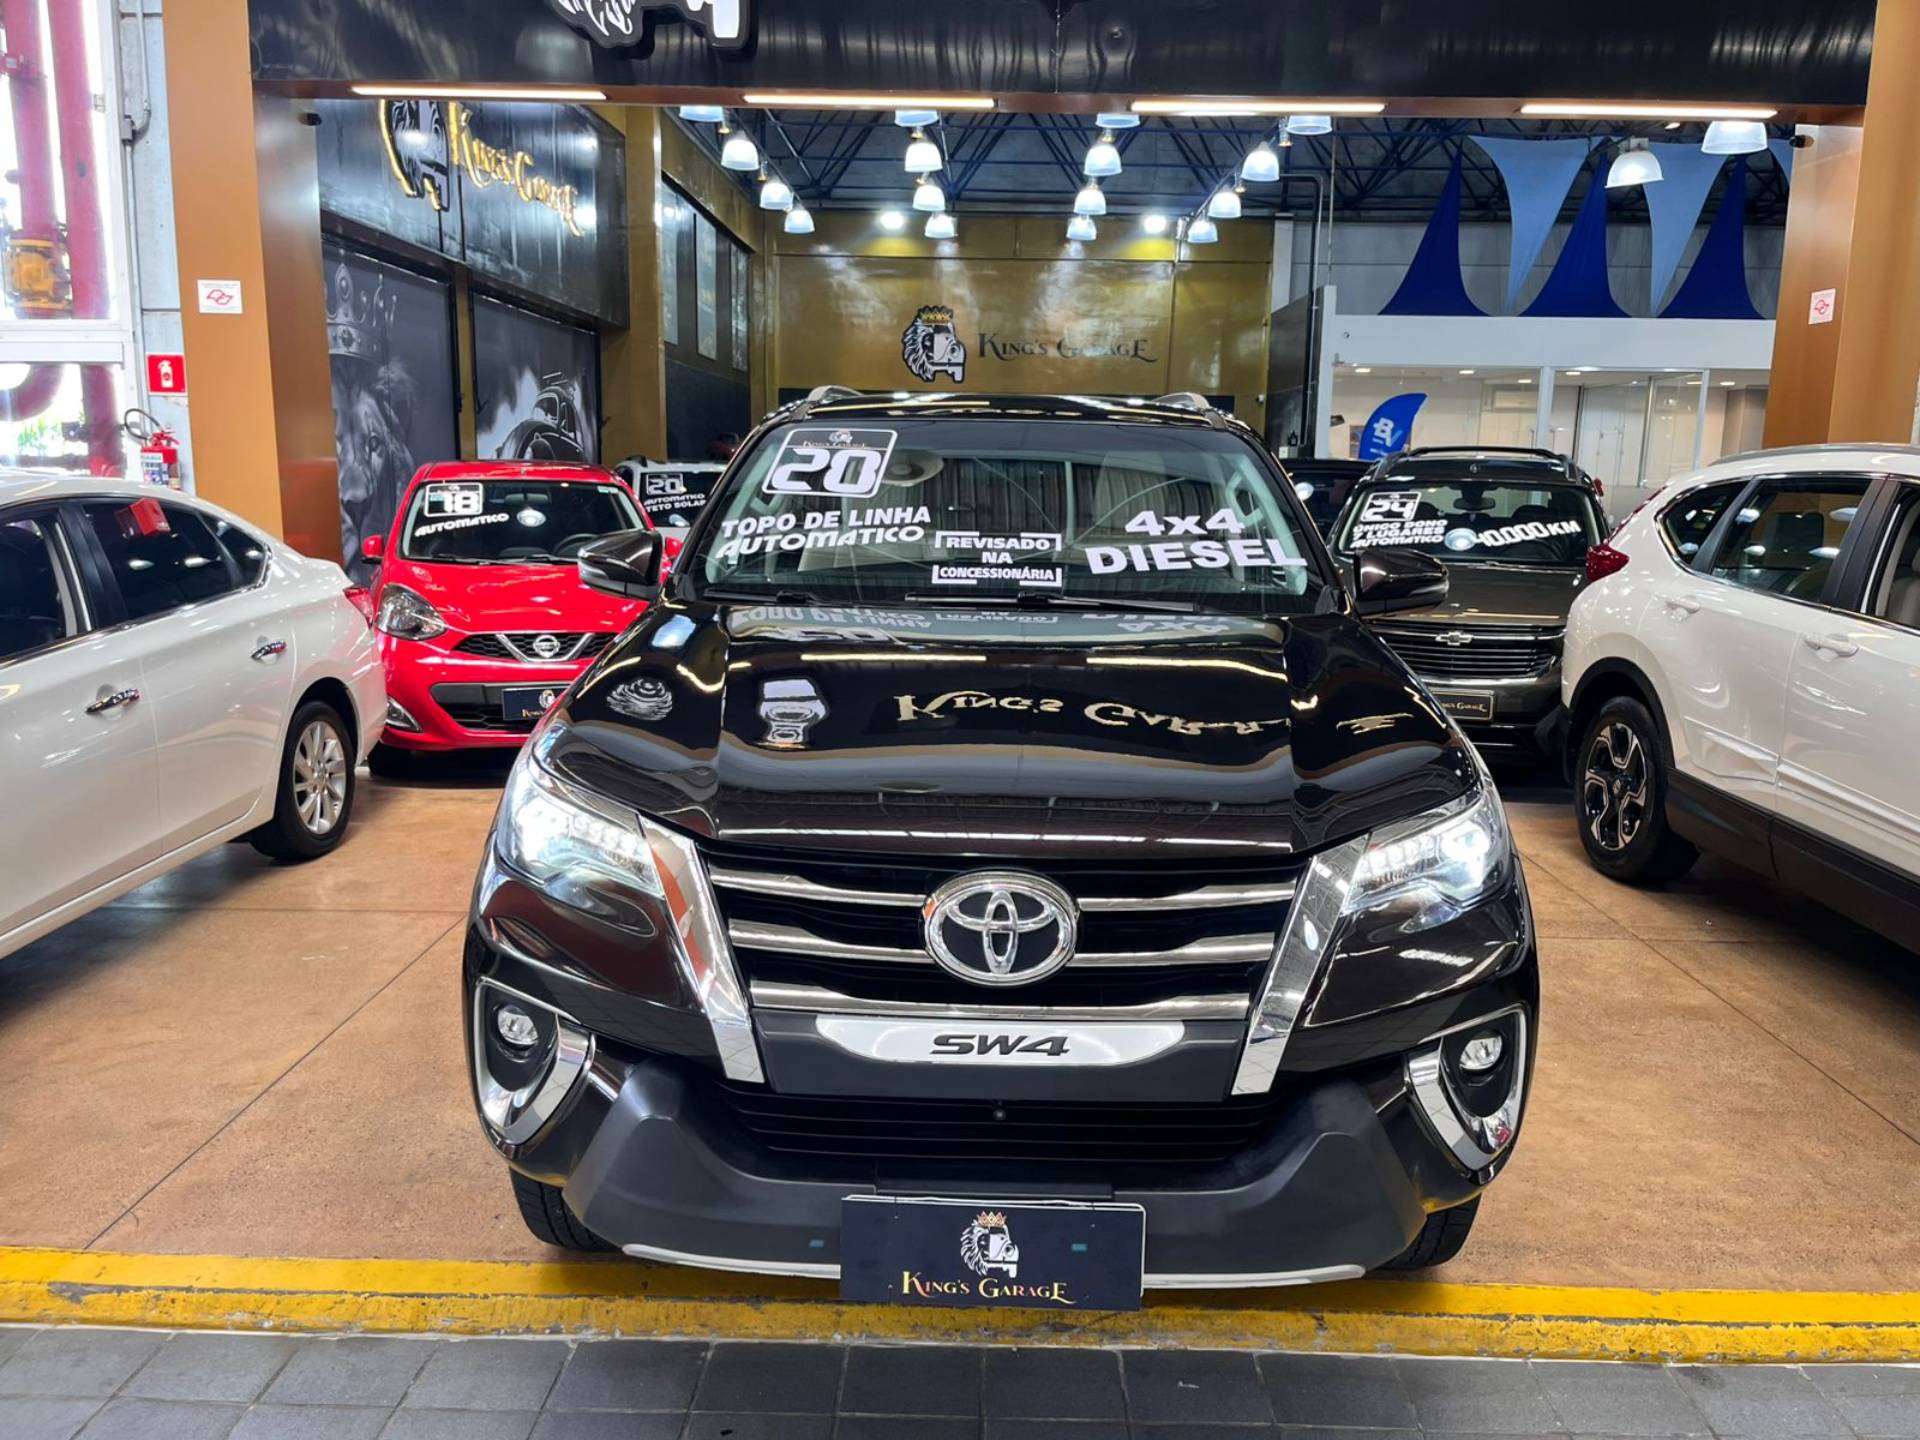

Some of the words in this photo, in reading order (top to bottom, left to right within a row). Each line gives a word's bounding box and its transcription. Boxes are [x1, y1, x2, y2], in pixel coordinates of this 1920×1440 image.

[977, 333, 1048, 361] KING'S
[1056, 336, 1158, 362] GAGE
[770, 448, 882, 494] 20
[648, 478, 681, 495] 20
[438, 491, 480, 513] 18
[646, 503, 673, 513] TETO
[1364, 499, 1415, 521] 24
[721, 513, 797, 538] TOPO
[804, 511, 841, 529] DE
[848, 505, 931, 527] LINHA
[946, 537, 1050, 551] REVISADO
[981, 551, 1014, 564] NA
[1084, 538, 1308, 575] DIESEL
[940, 566, 1054, 580] CONCESSIONÁRIA
[930, 1033, 1071, 1057] SW4
[902, 1271, 971, 1298] KING'S
[978, 1278, 1078, 1305] GARAGE
